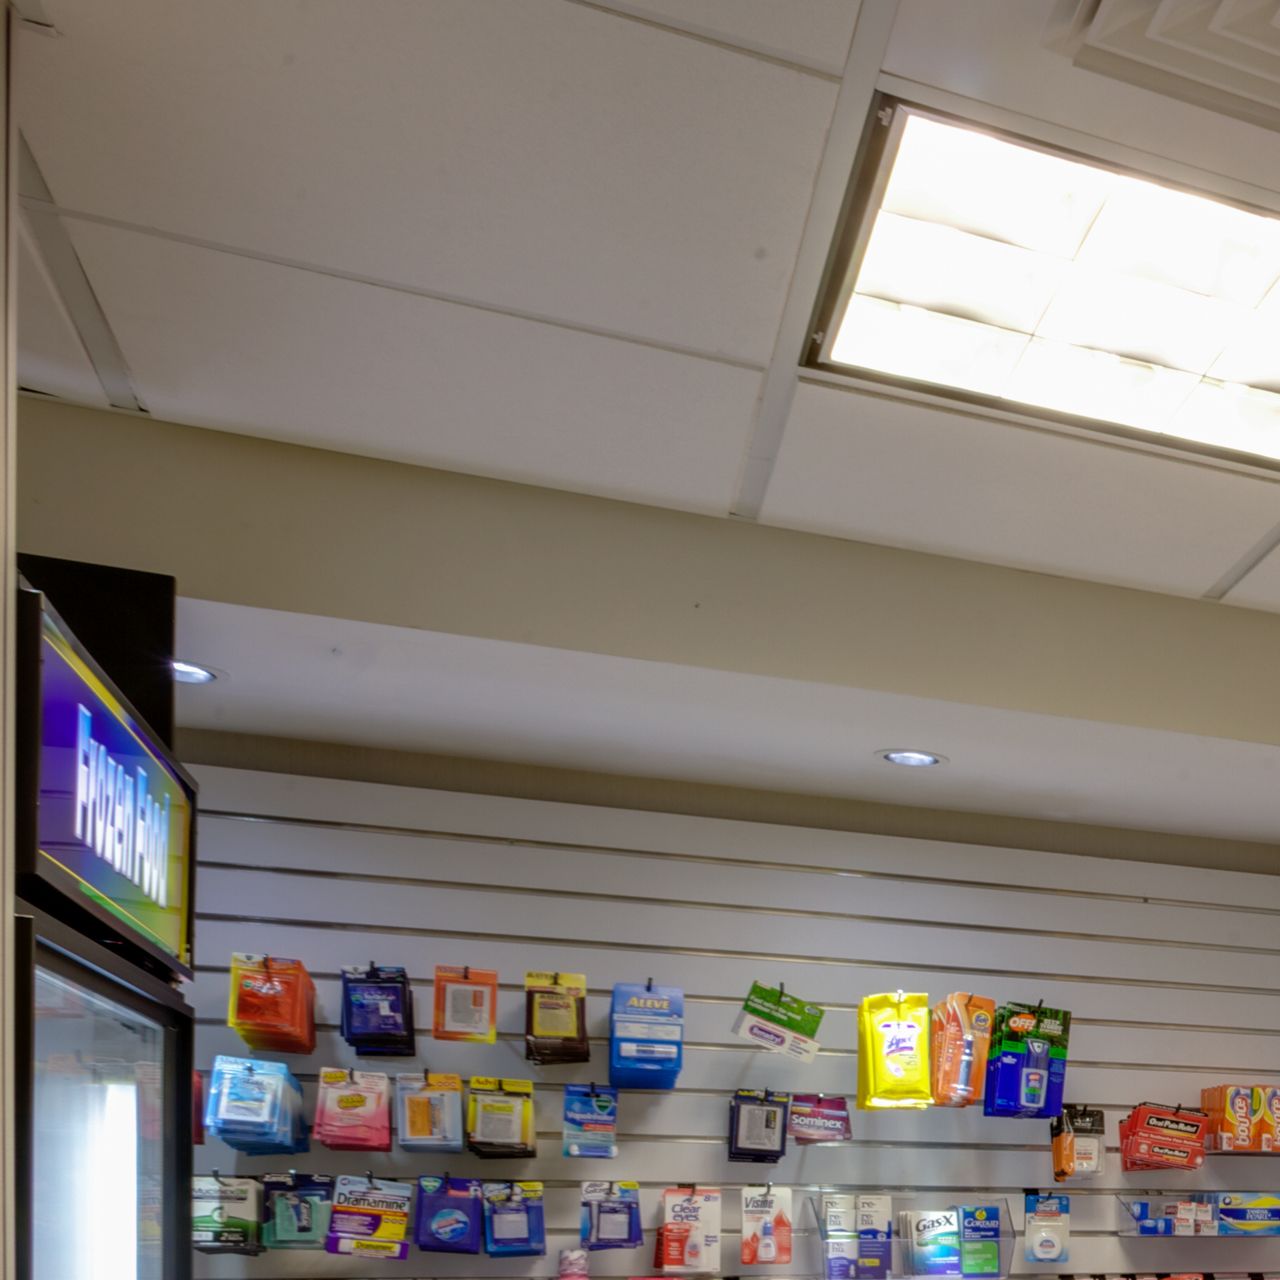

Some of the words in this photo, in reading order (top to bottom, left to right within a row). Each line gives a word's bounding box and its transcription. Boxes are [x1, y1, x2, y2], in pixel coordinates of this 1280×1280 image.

[133, 765, 171, 909] Food
[626, 995, 671, 1010] ALEVE
[1008, 1016, 1037, 1030] OFF!
[791, 1114, 844, 1130] Sominex
[1149, 1117, 1165, 1127] Oral
[1166, 1119, 1178, 1130] Pain
[1178, 1122, 1197, 1134] Relief
[1235, 1095, 1251, 1146] bounce
[336, 1192, 407, 1211] Dramamine
[671, 1204, 701, 1214] Clear
[672, 1213, 699, 1222] eyes
